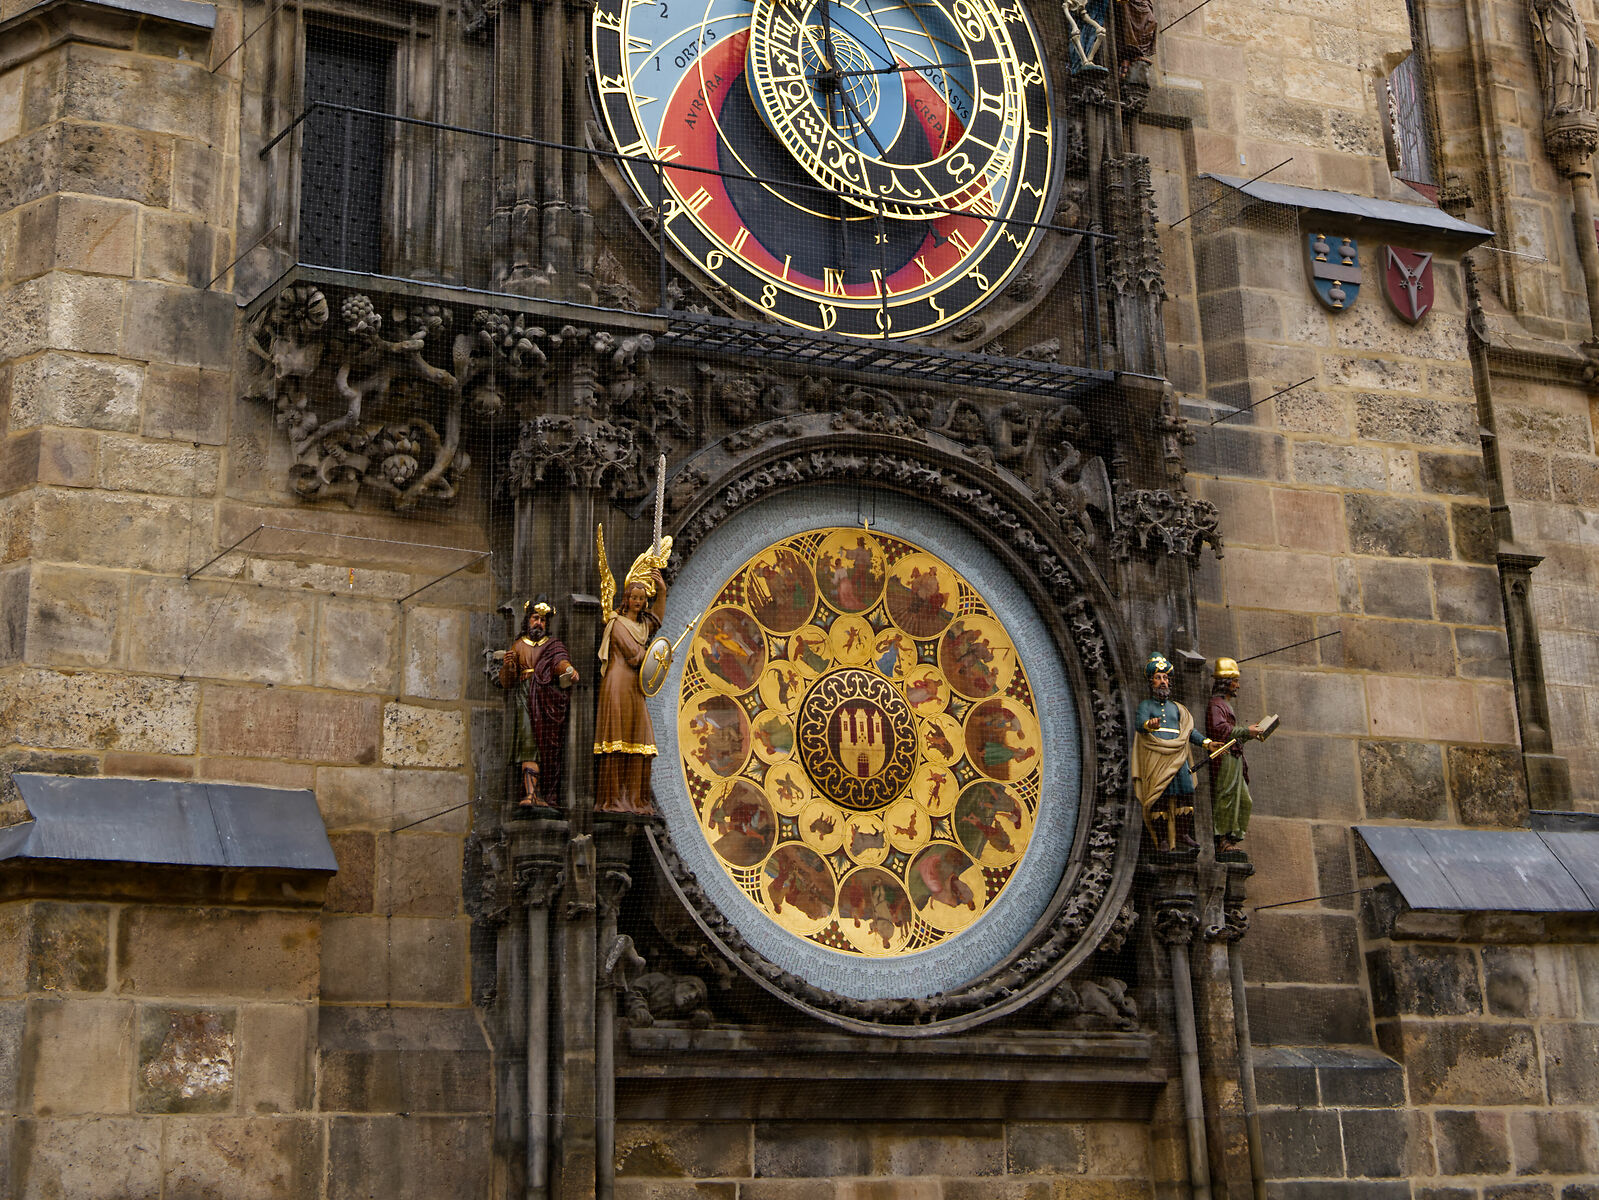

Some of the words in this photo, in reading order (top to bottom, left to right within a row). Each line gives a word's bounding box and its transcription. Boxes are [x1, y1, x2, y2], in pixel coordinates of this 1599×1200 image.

[660, 2, 669, 19] 2
[674, 28, 716, 69] ORTVS
[655, 56, 661, 72] 1
[684, 72, 725, 130] AVRORA
[913, 255, 936, 284] X
